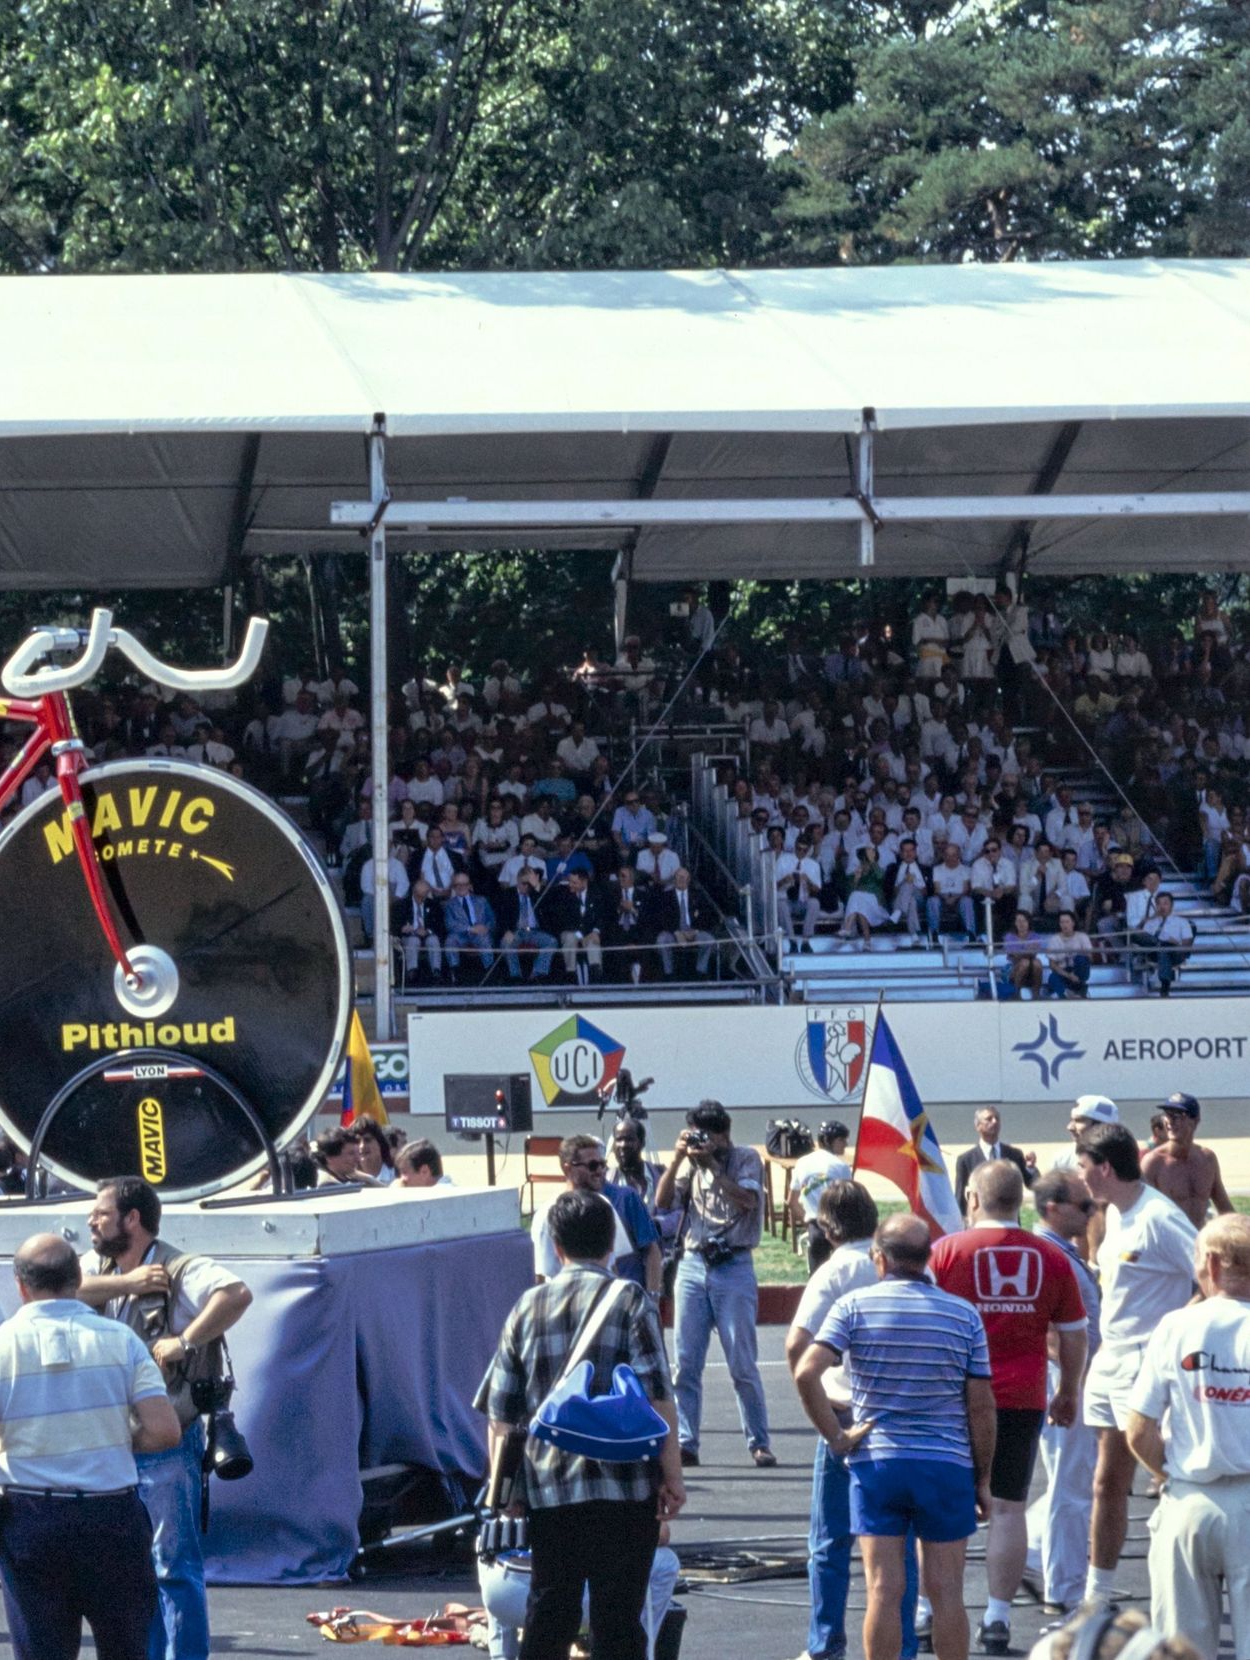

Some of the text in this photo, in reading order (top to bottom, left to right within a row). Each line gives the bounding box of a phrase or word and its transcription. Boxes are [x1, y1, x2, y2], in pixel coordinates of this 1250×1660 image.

[43, 786, 214, 864] MAVIC
[95, 839, 182, 863] OMETE
[62, 1016, 236, 1051] Pithioud
[1103, 1037, 1248, 1060] AEROPORT
[135, 1067, 165, 1077] LYON
[555, 1045, 597, 1087] UCI
[460, 1116, 497, 1128] TISSOT
[141, 1102, 163, 1177] MAVIC
[975, 1303, 1037, 1313] HONDA
